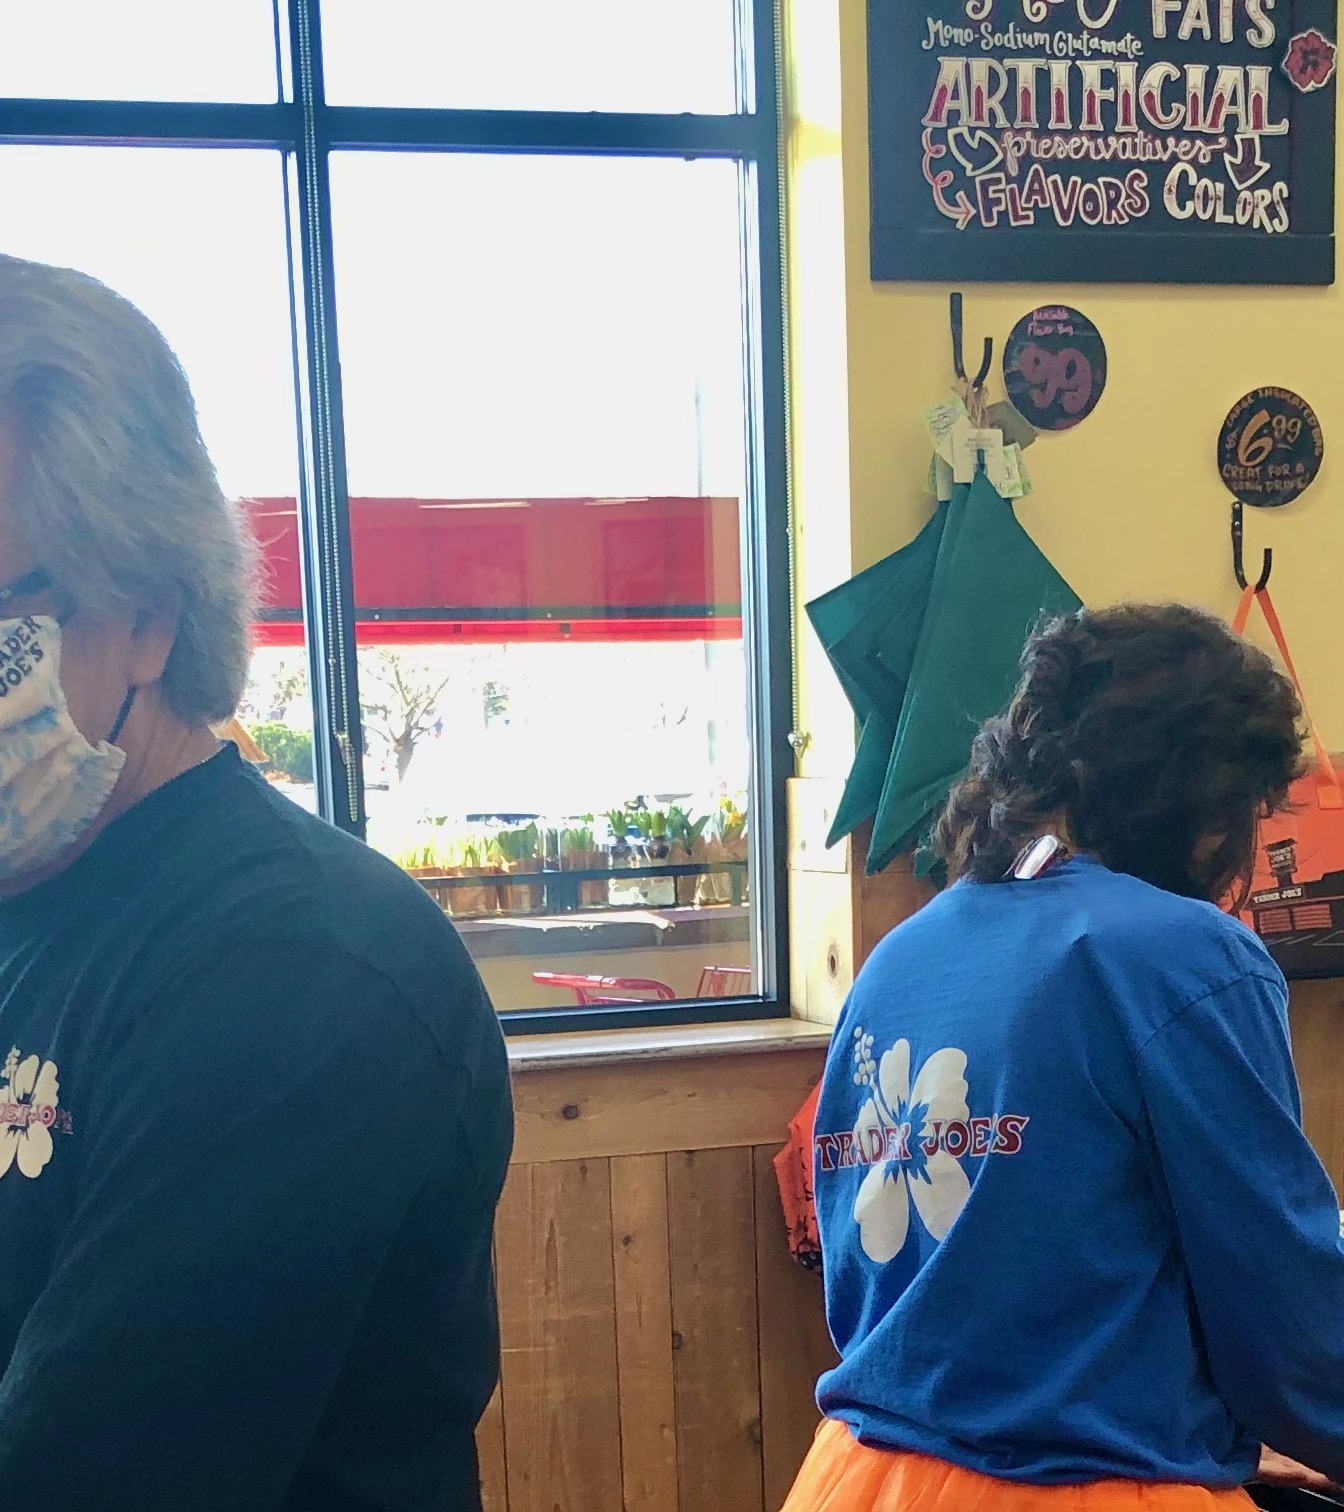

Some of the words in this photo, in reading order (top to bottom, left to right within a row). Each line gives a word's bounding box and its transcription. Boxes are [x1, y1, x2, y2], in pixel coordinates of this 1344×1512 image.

[1053, 32, 1145, 59] Glutamate
[921, 56, 1289, 135] ARTIFICIAL
[1001, 130, 1228, 176] preservatives
[974, 163, 1149, 228] FLAVORS
[1163, 161, 1289, 234] COLORS
[1267, 463, 1291, 478] FOR
[815, 1123, 912, 1171] TRADER
[919, 1112, 1031, 1160] JOE'S
